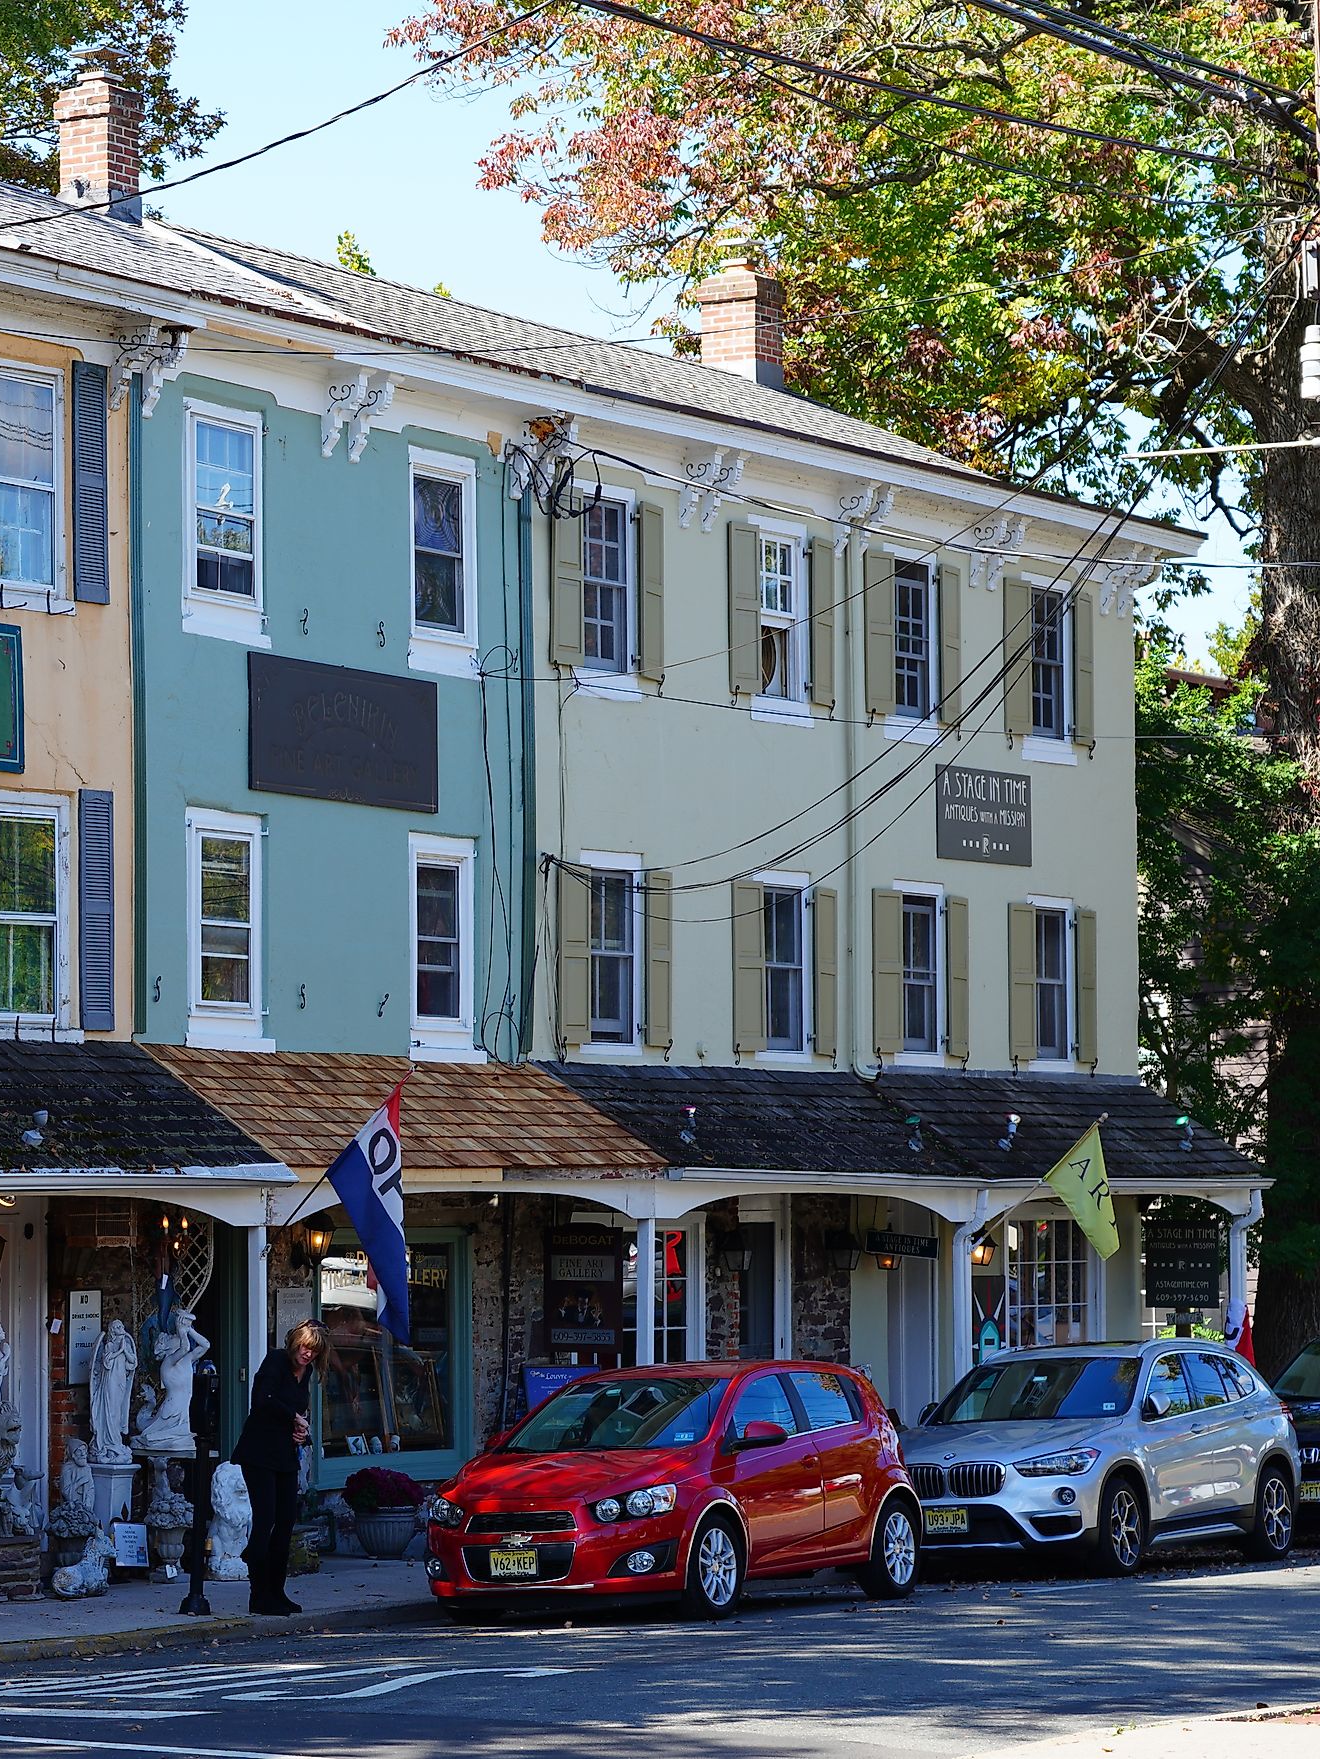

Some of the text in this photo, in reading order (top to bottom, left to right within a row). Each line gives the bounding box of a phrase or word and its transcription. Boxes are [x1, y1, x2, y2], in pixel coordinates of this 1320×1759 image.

[942, 771, 1027, 807] A STAGE IN TIME
[944, 803, 979, 823] ANTIQUES
[999, 809, 1026, 828] MISSION
[1147, 1228, 1217, 1240] A STAGE IN TIME
[881, 1233, 901, 1244] STAGE
[913, 1237, 929, 1247] TIME
[884, 1243, 921, 1254] ANTIQUES
[559, 1258, 604, 1268] FINE ART
[558, 1267, 604, 1277] GALLERY
[406, 1267, 449, 1290] LLERY
[1155, 1280, 1210, 1289] ASTAGEINTIME.COM
[80, 1295, 88, 1304] NO
